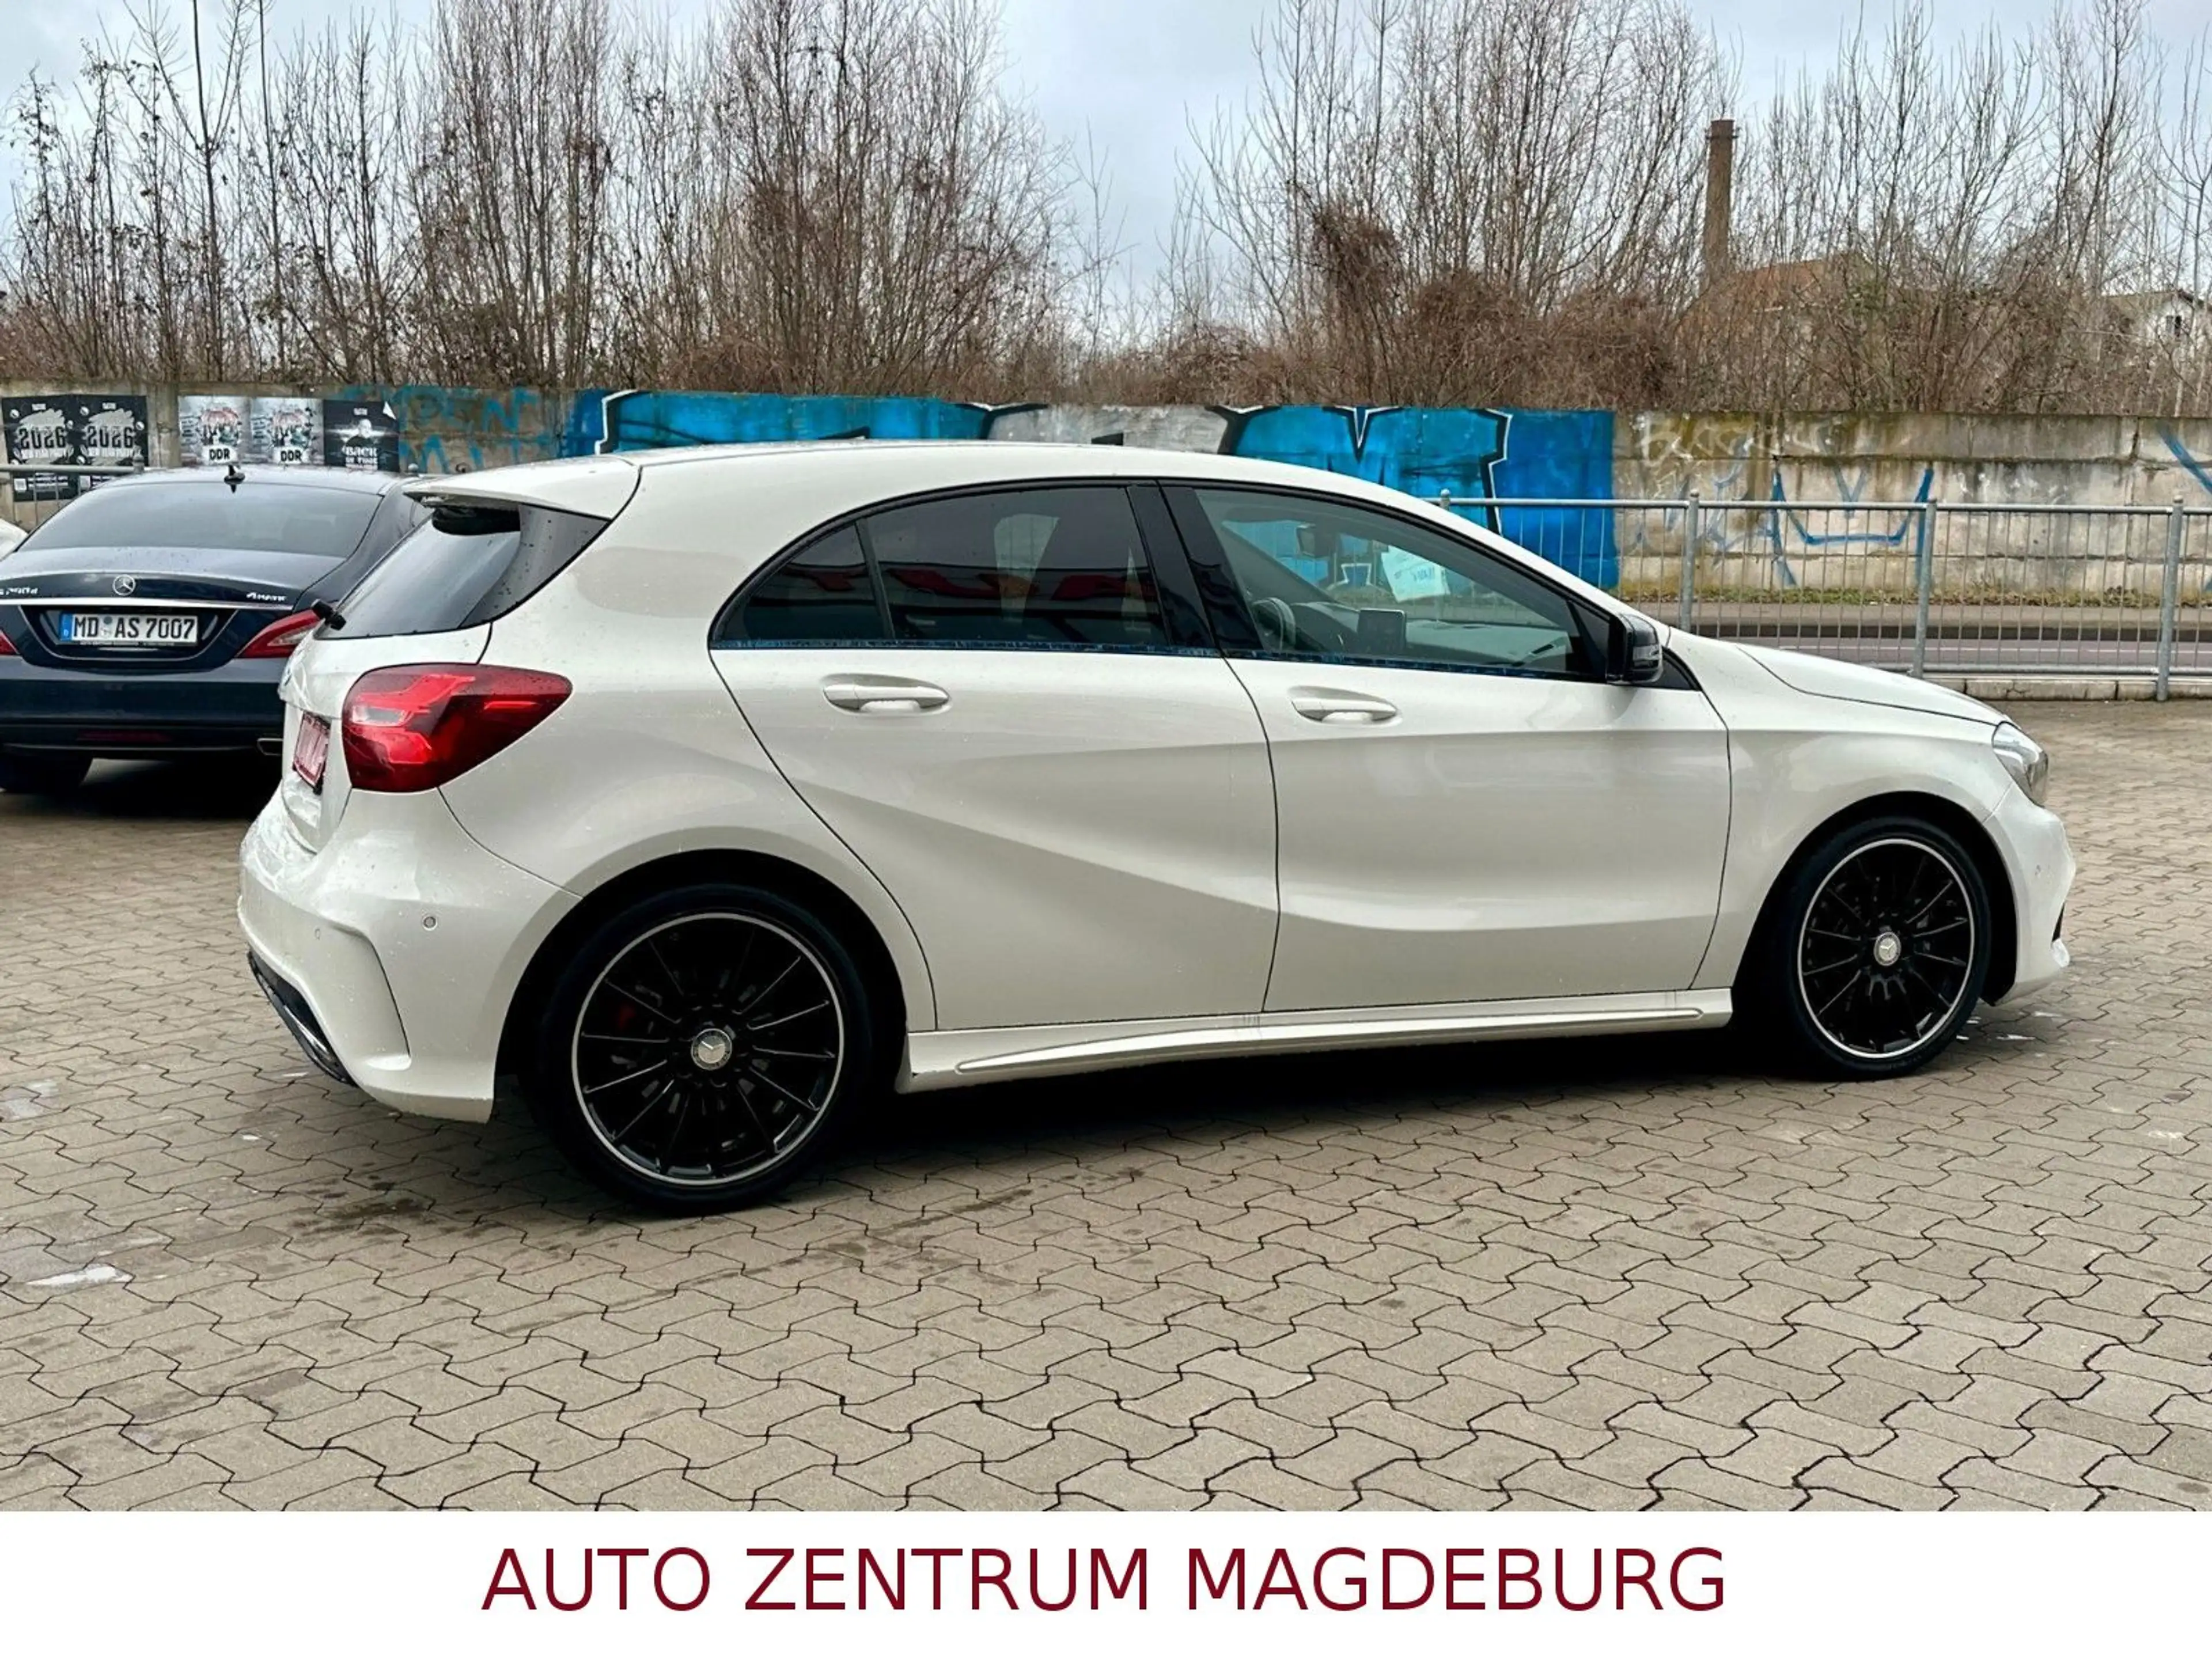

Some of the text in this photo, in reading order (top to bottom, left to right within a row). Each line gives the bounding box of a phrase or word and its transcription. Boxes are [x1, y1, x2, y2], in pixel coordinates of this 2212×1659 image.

[19, 426, 66, 449] 2026
[88, 426, 134, 448] 2026
[209, 448, 230, 460] DDR
[281, 450, 302, 461] DDR
[74, 616, 195, 639] MD AS 7007
